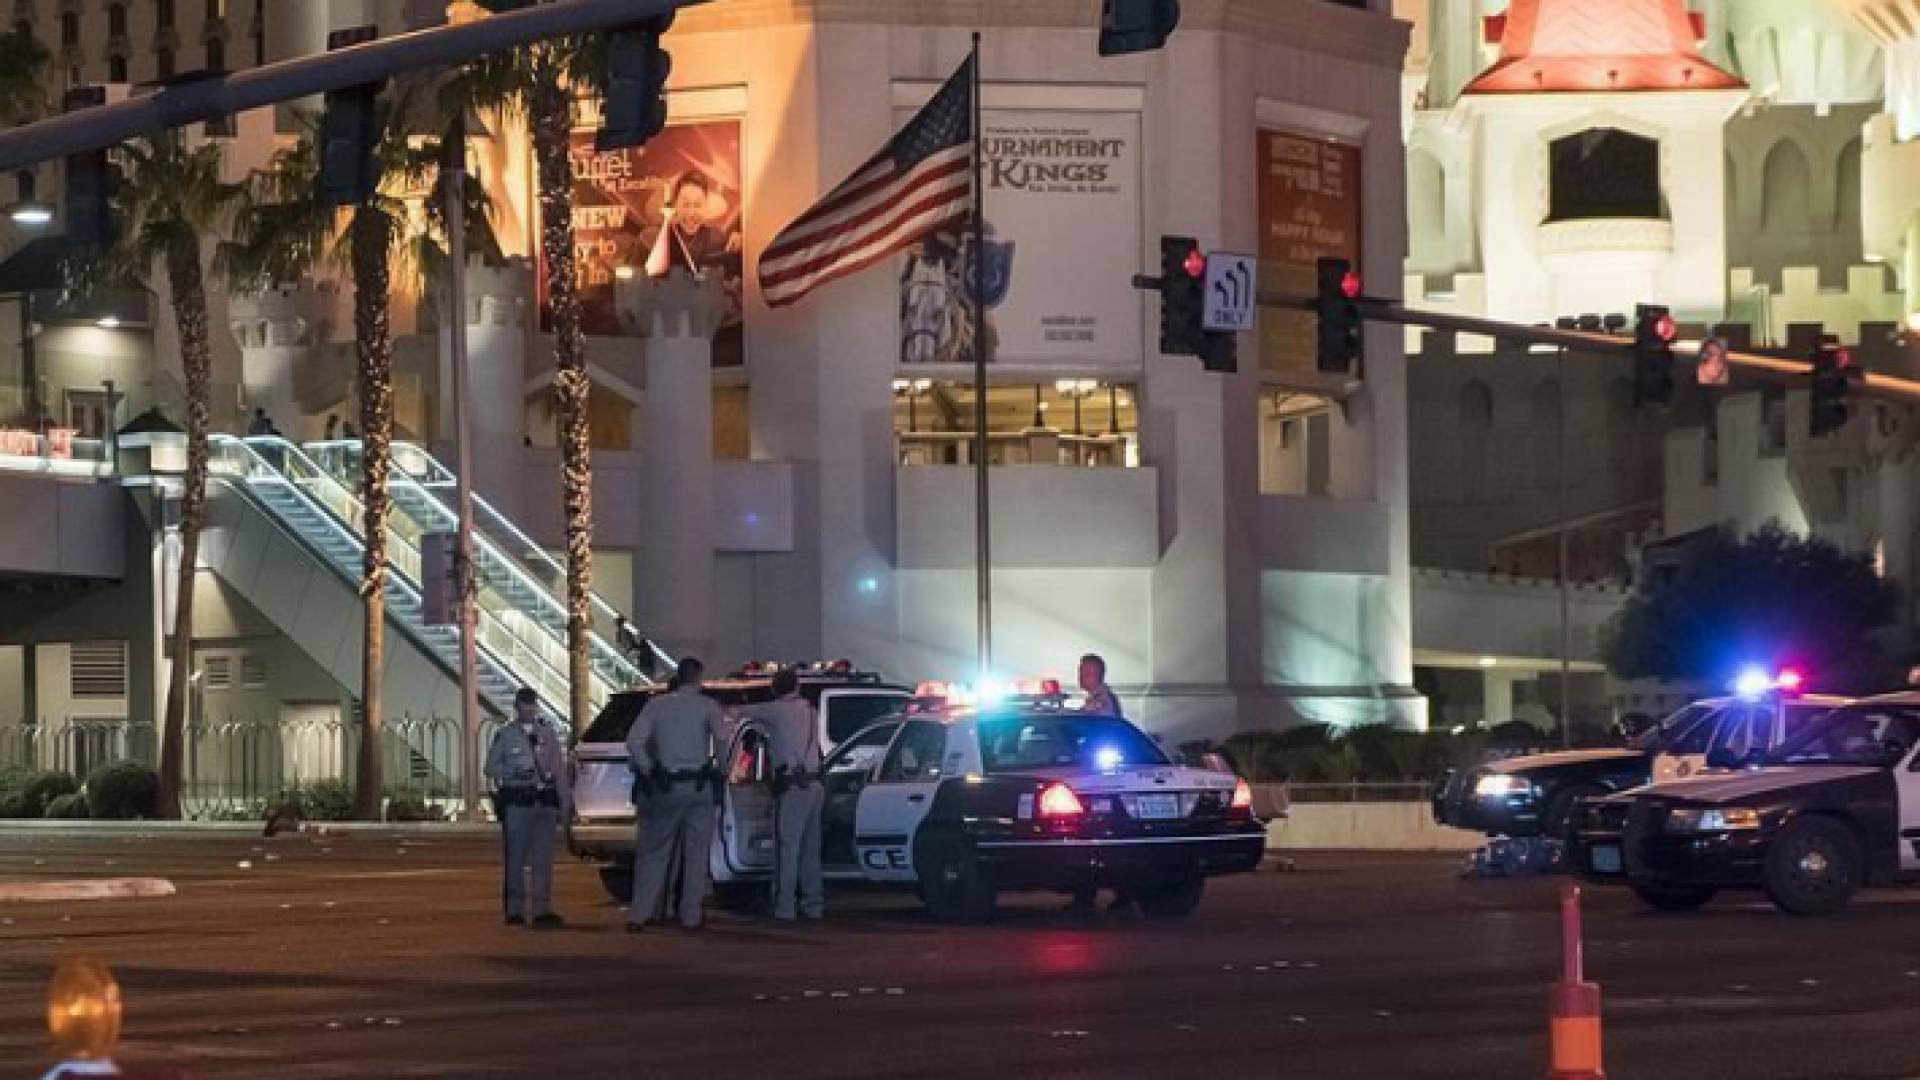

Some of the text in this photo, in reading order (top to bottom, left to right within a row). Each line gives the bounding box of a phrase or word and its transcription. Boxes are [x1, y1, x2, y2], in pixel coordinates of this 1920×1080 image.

[981, 137, 1124, 158] URNAMENT
[990, 159, 1108, 189] KINGS
[571, 205, 627, 229] NEW
[1214, 309, 1245, 324] ONLY
[864, 848, 908, 869] CE
